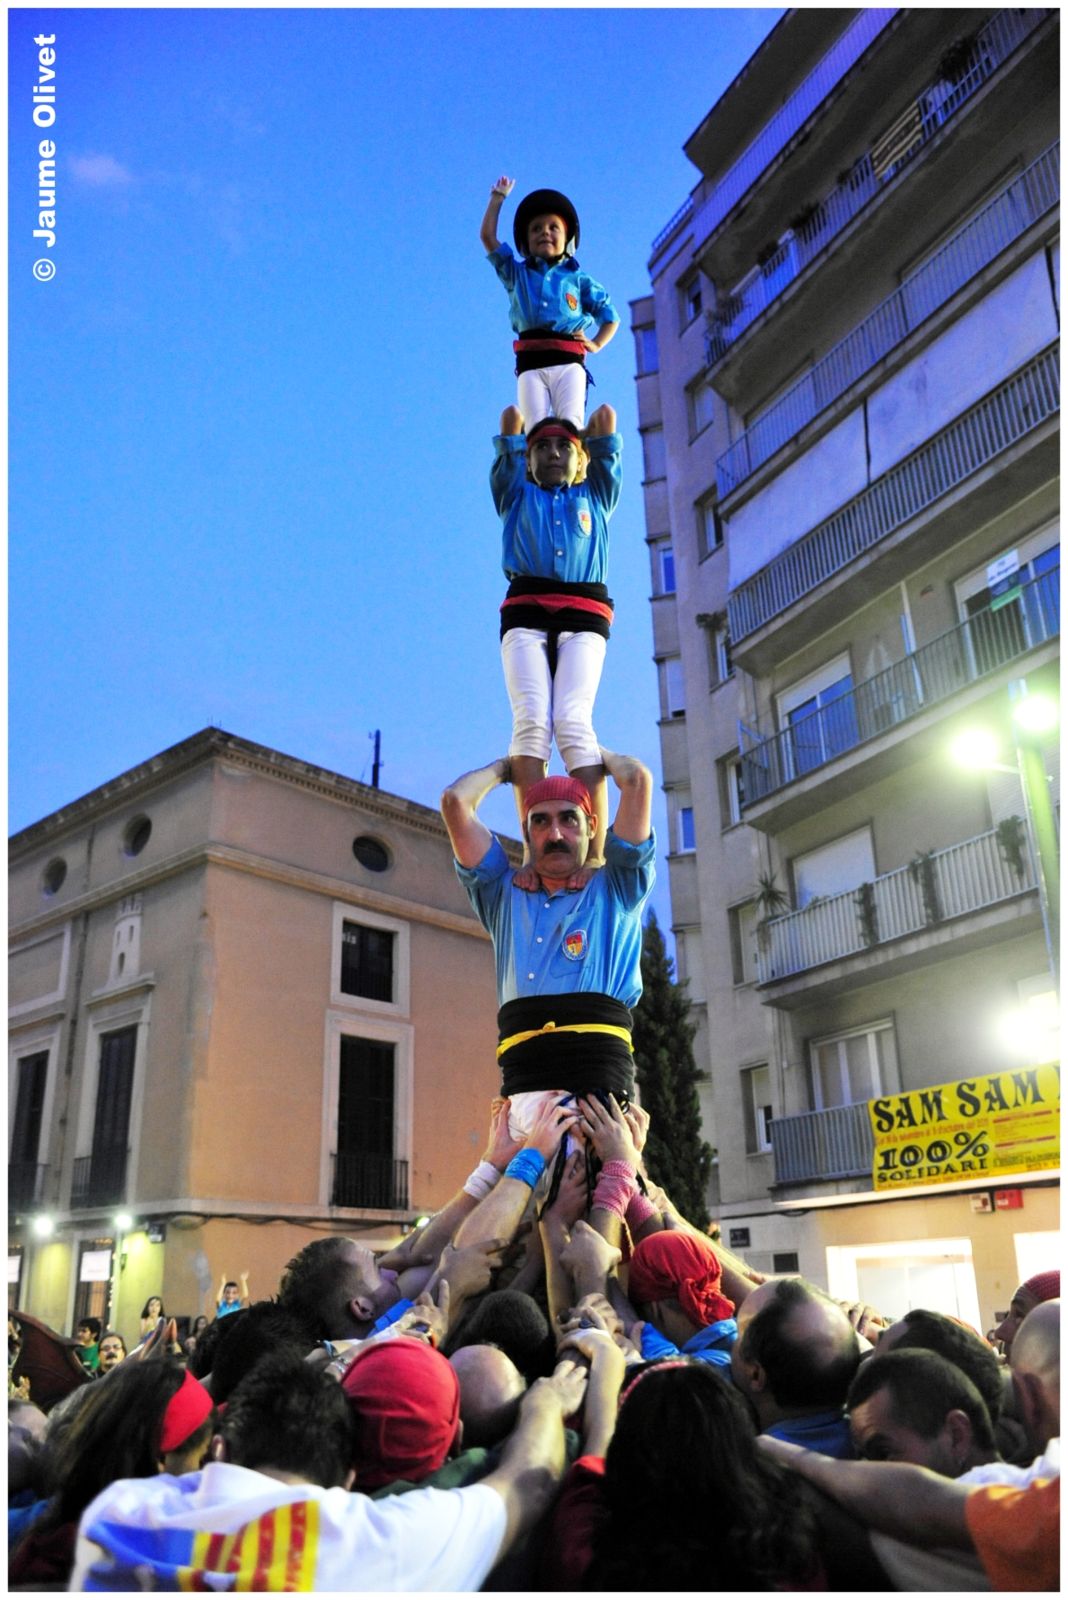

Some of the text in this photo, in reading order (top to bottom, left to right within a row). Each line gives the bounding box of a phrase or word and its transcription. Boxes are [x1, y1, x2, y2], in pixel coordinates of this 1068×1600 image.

[873, 1088, 949, 1133] SAM
[956, 1069, 1045, 1118] SAM
[877, 1130, 990, 1171] 100%
[877, 1158, 988, 1183] SOLIDARI
